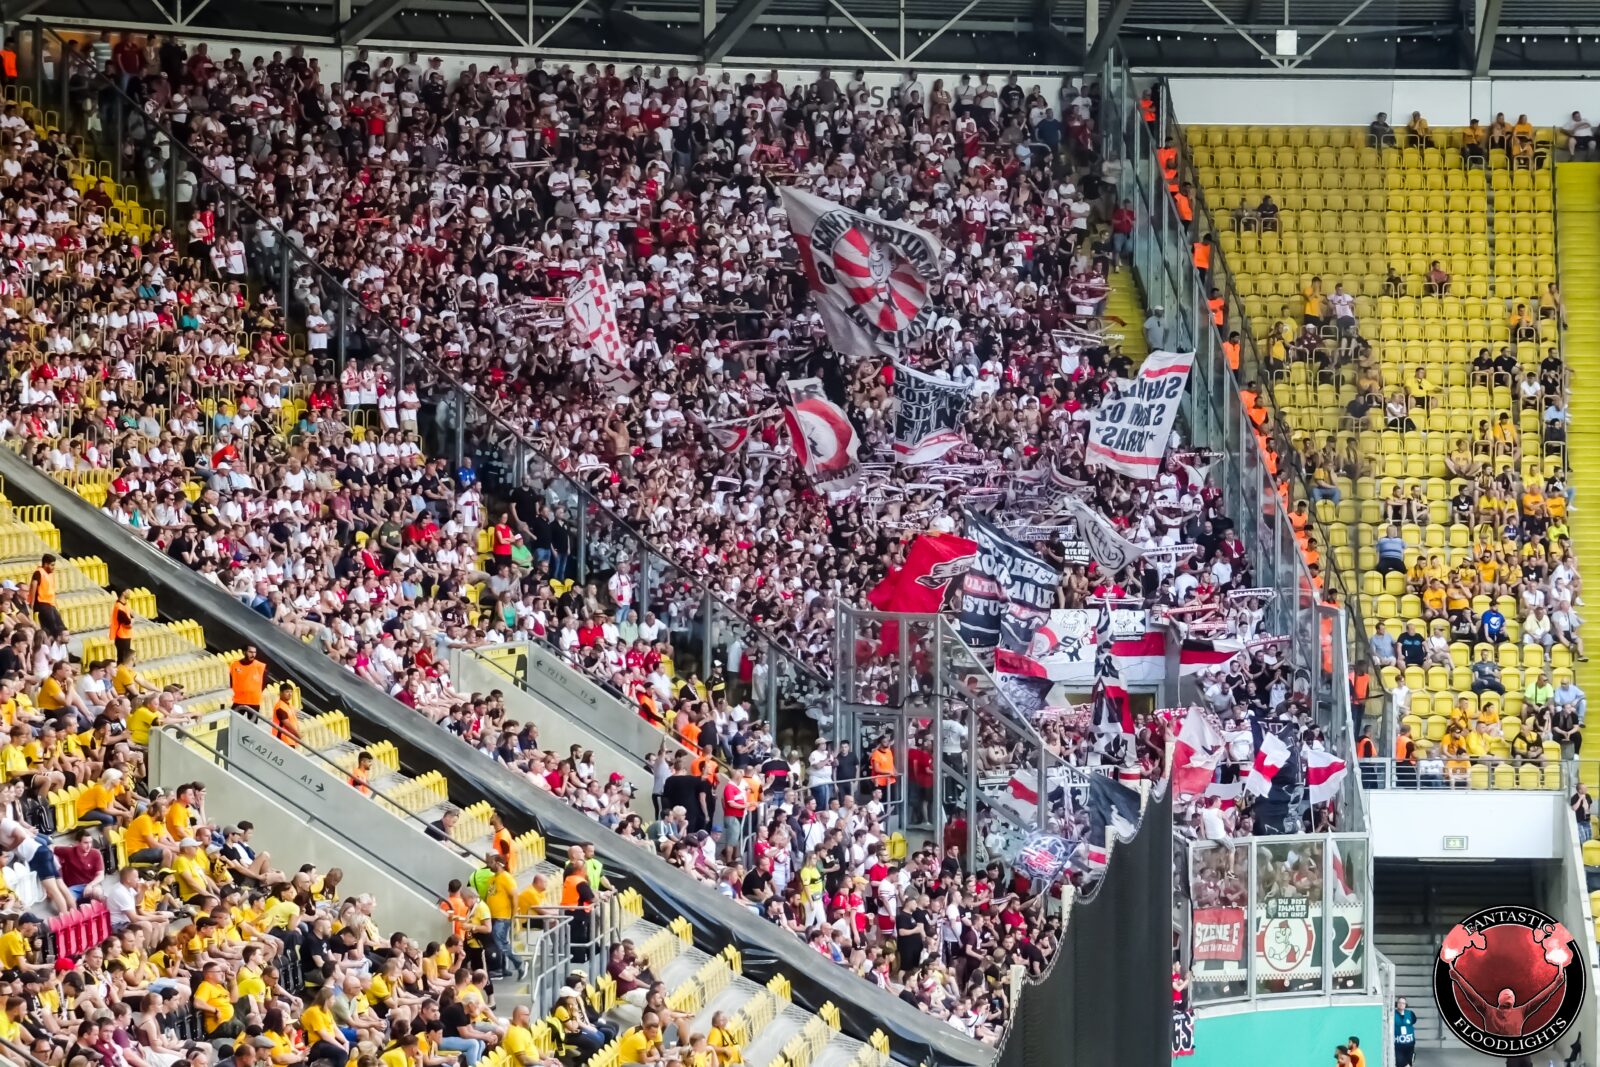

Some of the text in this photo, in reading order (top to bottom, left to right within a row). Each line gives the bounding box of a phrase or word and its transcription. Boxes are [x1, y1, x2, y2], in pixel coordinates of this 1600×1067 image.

[255, 745, 267, 755] A2
[272, 757, 284, 767] A3
[300, 774, 313, 785] A1
[1195, 922, 1240, 948] SZENE E
